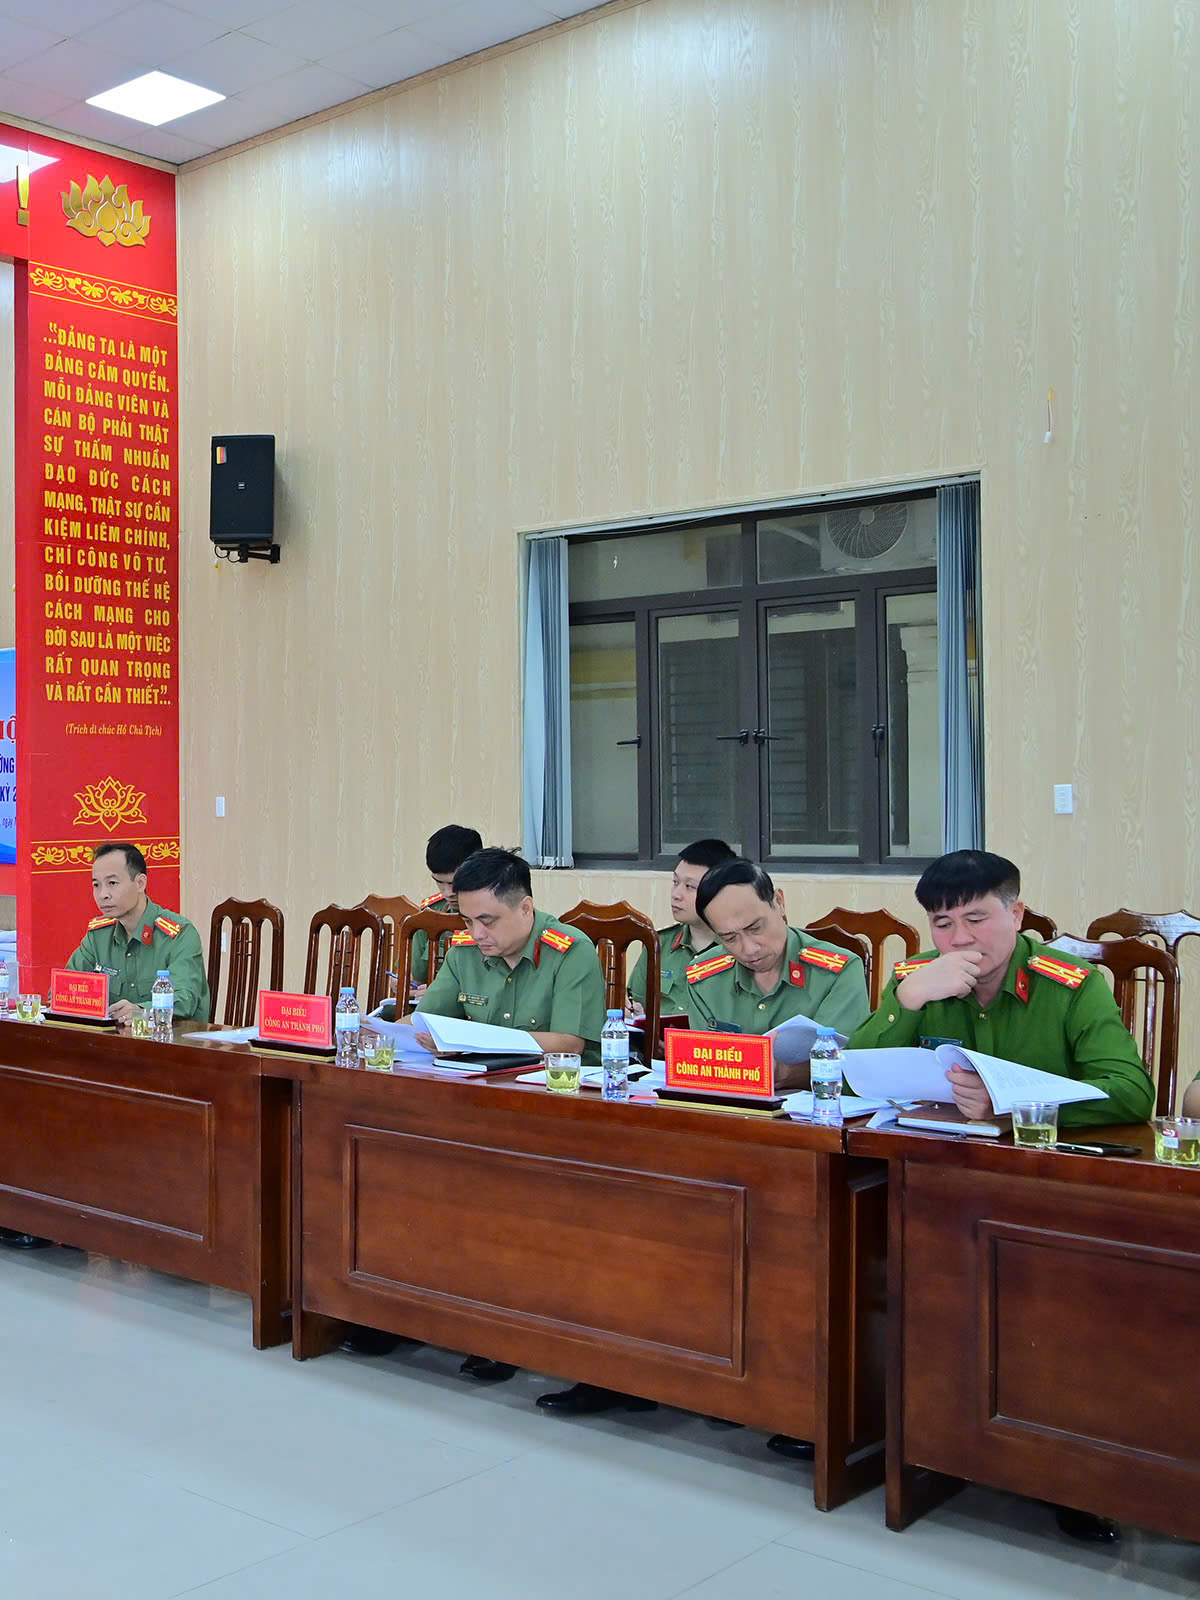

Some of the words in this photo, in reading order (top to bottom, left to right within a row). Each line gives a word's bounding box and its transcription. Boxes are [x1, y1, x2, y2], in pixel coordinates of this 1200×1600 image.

[45, 350, 84, 377] ĐẢNG
[88, 360, 118, 383] CẦM
[100, 337, 116, 356] TA
[120, 340, 136, 361] LÀ
[140, 345, 167, 368] MỘT
[44, 377, 71, 401] MỖI
[75, 383, 113, 409] ĐẢNG
[117, 393, 148, 415] VIÊN
[152, 400, 169, 419] VÀ
[44, 406, 71, 428] CÁN
[78, 412, 96, 435] BỘ
[103, 415, 132, 438] PHẢI
[139, 424, 169, 446] THẬT
[43, 435, 64, 457] SỰ
[74, 438, 112, 462] THẤM
[45, 463, 76, 485] ĐẠO
[89, 467, 119, 489] ĐỨC
[131, 474, 171, 497] CÁCH
[44, 490, 88, 514] MẠNG,
[91, 496, 122, 519] THẬT
[125, 501, 144, 523] SỰ
[145, 499, 171, 523] CẦN
[44, 517, 81, 540] KIỆM
[86, 521, 120, 543] LIÊM
[124, 527, 170, 550] CHÍNH,
[44, 544, 72, 565] CHÍ
[77, 546, 118, 569] CÔNG
[123, 551, 141, 571] VÔ
[45, 569, 69, 592] BỒI
[74, 575, 121, 596] DƯỠNG
[125, 578, 150, 599] THẾ
[154, 581, 170, 603] HỆ
[45, 598, 82, 620] CÁCH
[94, 605, 134, 625] MẠNG
[144, 608, 170, 626] CHO
[45, 625, 67, 646] ĐỜI
[70, 630, 95, 648] SAU
[98, 629, 114, 649] LÀ
[116, 631, 142, 654] MỘT
[145, 633, 171, 655] VIỆC
[45, 651, 73, 674] RẤT
[81, 658, 119, 677] QUAN
[127, 661, 171, 682] TRỌNG
[46, 681, 63, 701] VÀ
[67, 680, 91, 702] RẤT
[95, 682, 121, 703] CẦN
[693, 1047, 712, 1061] ĐẠI
[715, 1046, 743, 1062] BIỂU
[676, 1061, 699, 1075] CÔNG
[700, 1065, 712, 1077] AN
[713, 1065, 741, 1080] THÀNH
[743, 1066, 760, 1082] PHỐ
